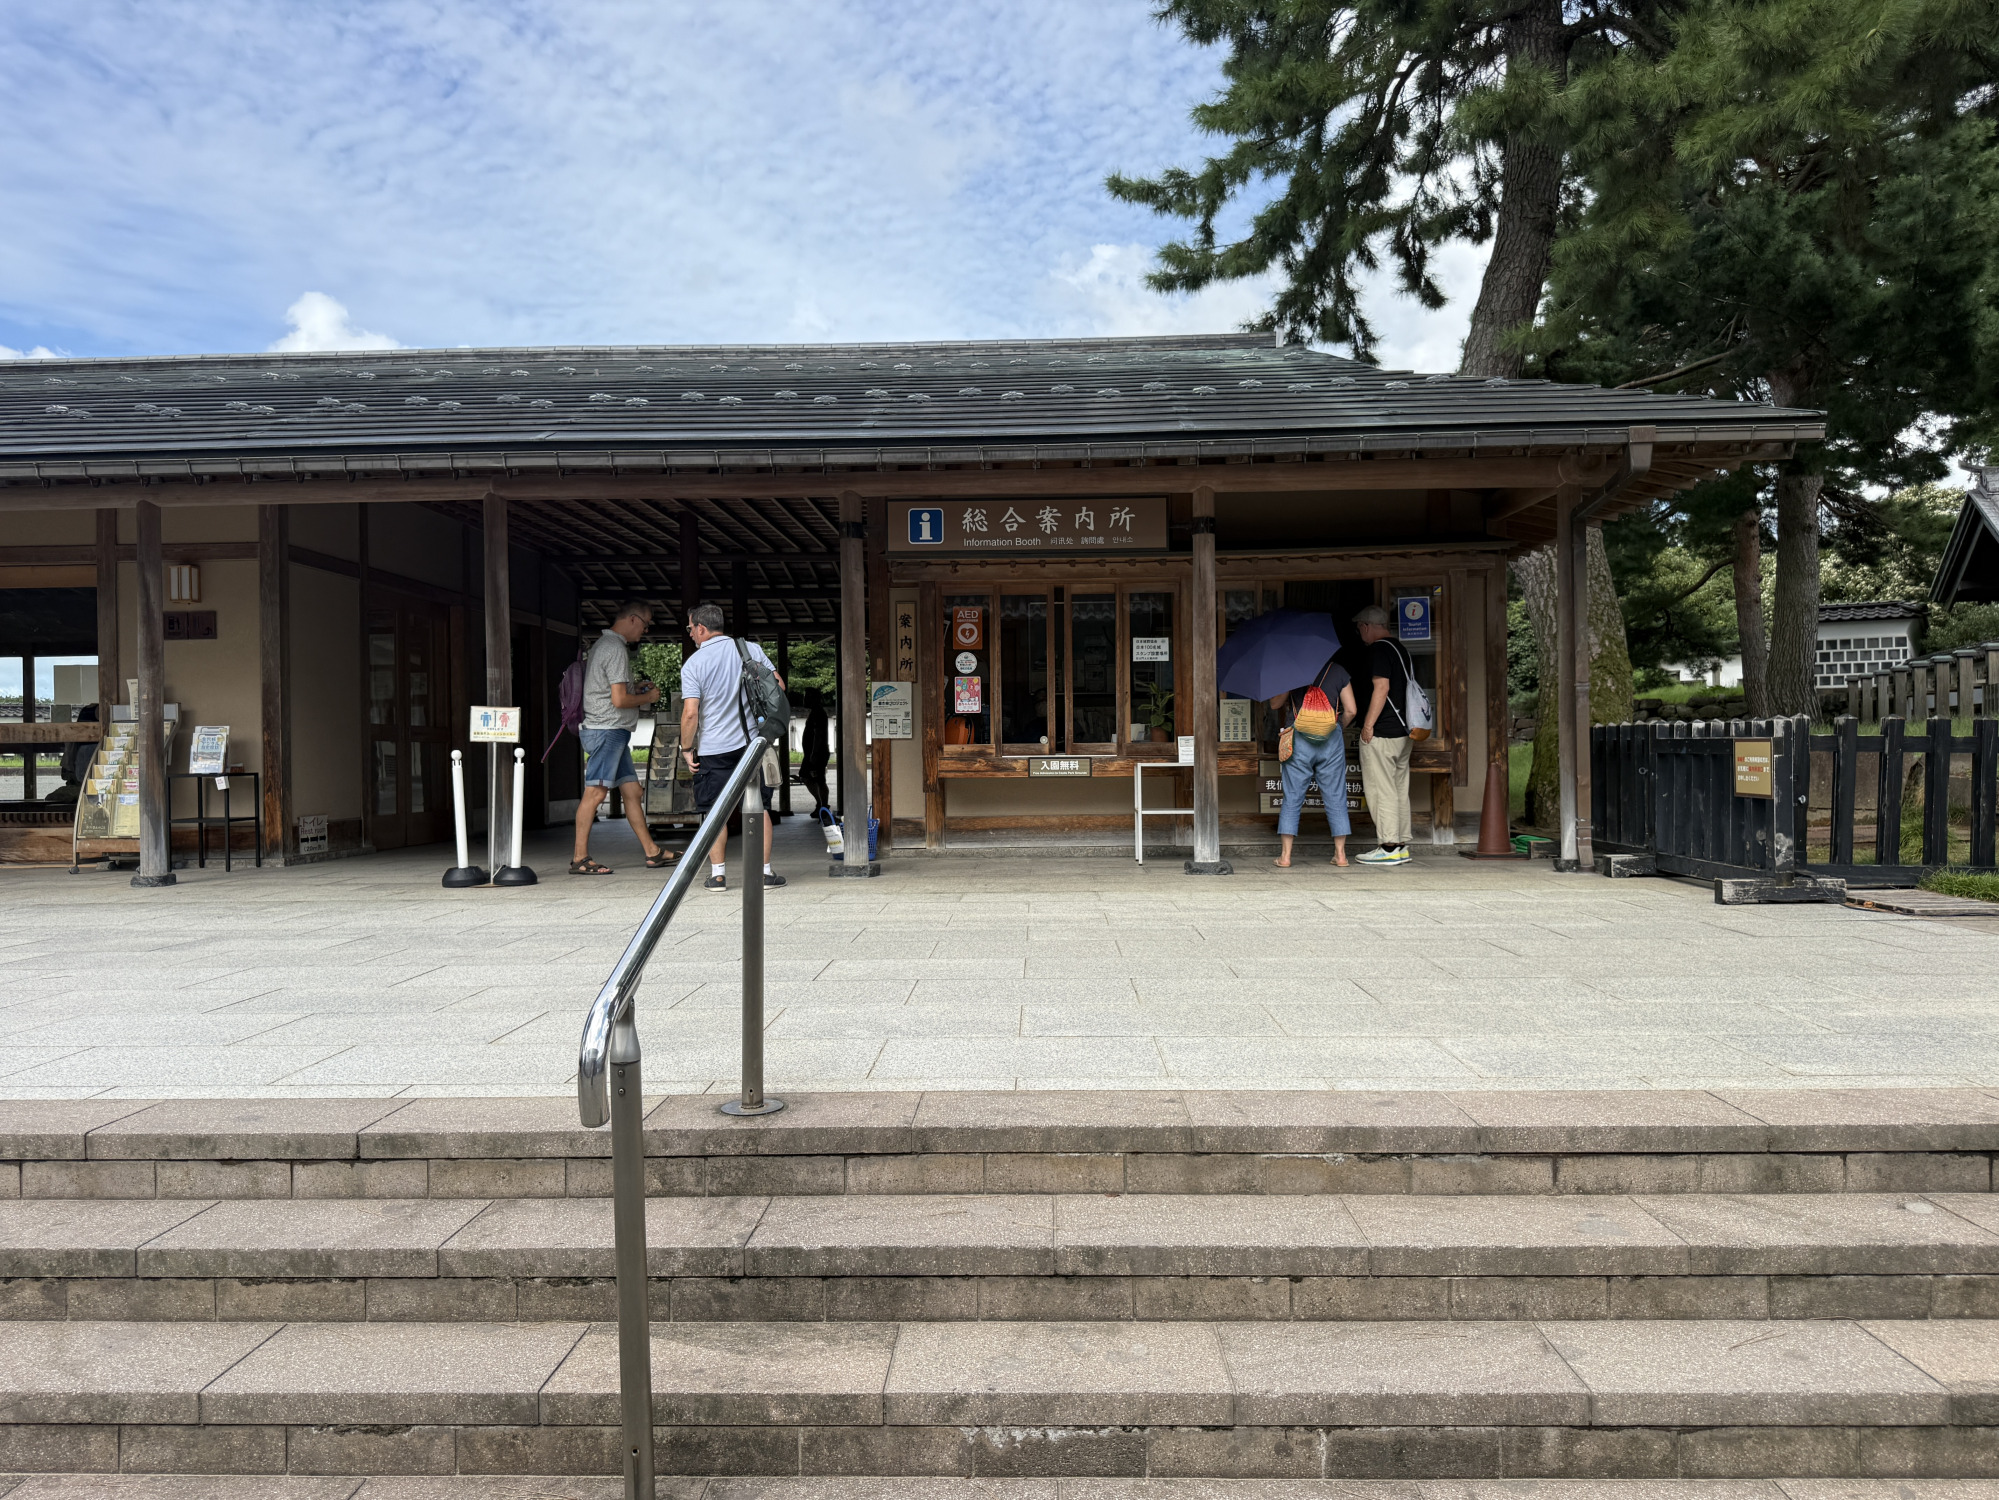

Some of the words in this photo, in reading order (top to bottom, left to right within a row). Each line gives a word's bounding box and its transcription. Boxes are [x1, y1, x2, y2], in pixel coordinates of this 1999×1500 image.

[961, 506, 1135, 535] 総合案内所
[963, 537, 1013, 547] Information
[1015, 537, 1041, 547] Booth
[1112, 536, 1133, 544] 안내소
[957, 610, 979, 619] AED
[899, 613, 914, 672] 案内所
[1040, 760, 1079, 771] 入園無料
[302, 816, 324, 827] トイレ
